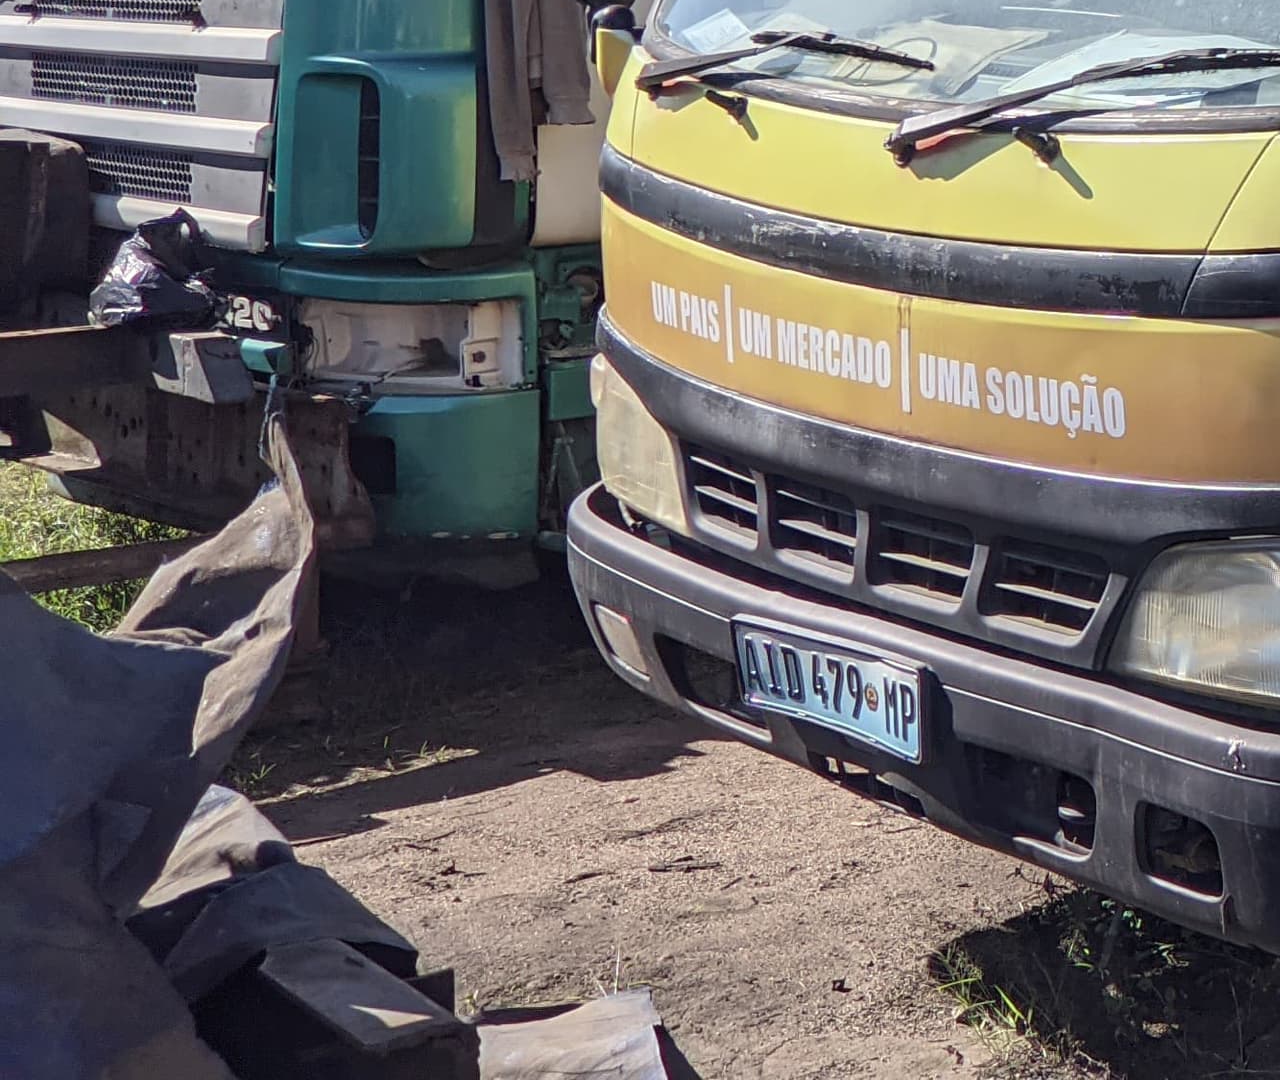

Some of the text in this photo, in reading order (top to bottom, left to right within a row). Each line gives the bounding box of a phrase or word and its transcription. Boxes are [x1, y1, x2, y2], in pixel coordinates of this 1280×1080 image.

[651, 280, 1126, 438] UM PAIS UM MERCADO UMA SOLUÇÃO
[744, 635, 917, 742] AID 479 MP
